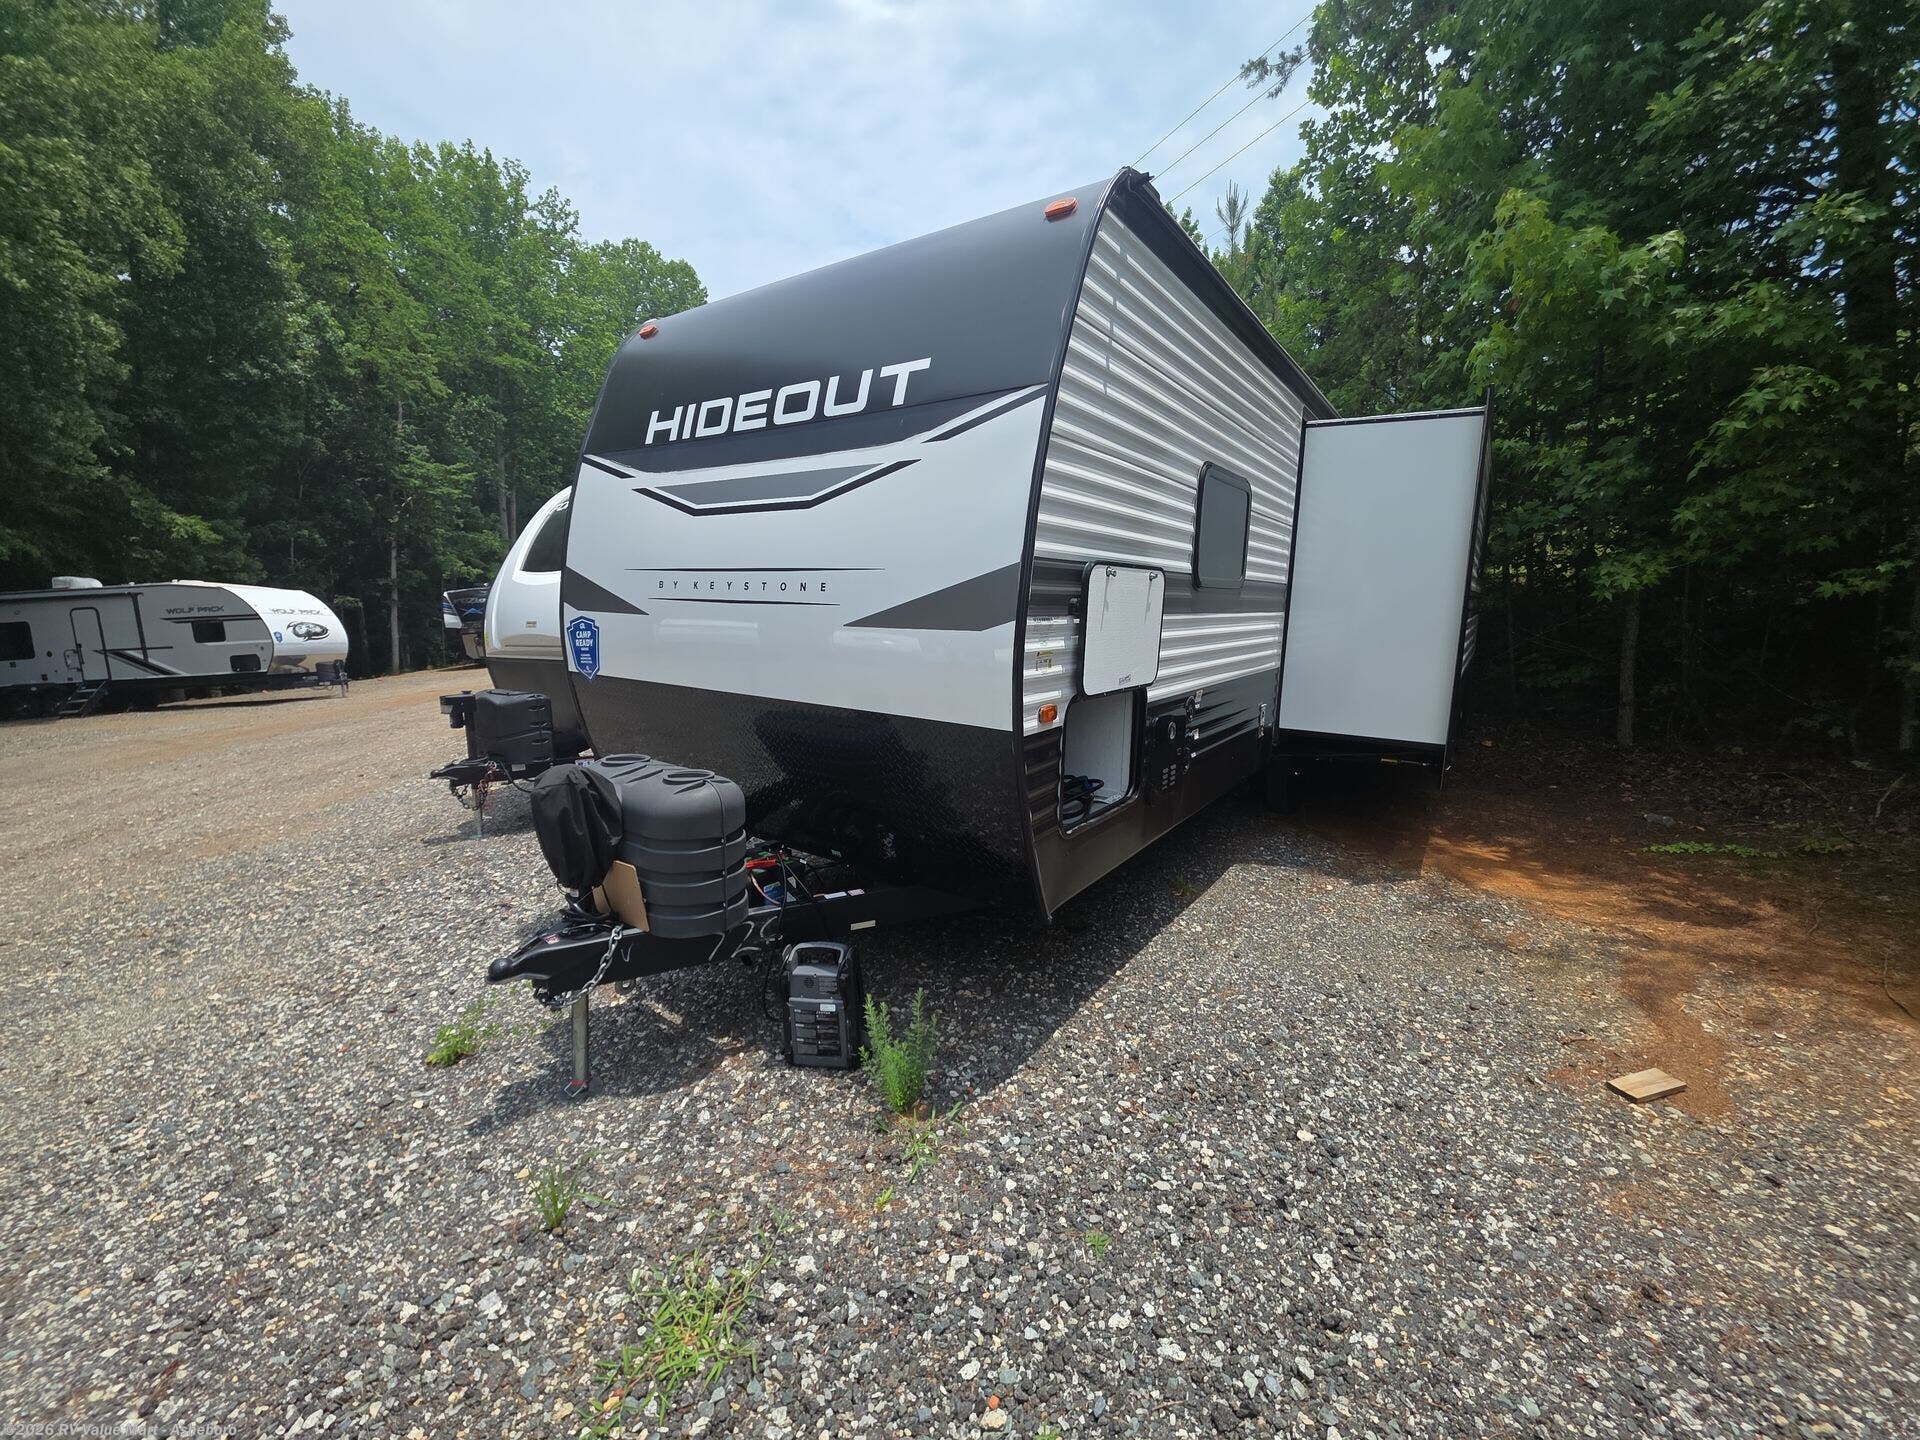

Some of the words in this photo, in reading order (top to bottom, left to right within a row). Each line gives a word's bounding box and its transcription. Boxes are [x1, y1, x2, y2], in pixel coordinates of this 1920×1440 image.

[644, 357, 932, 445] HIDEOUT
[658, 580, 679, 589] BY
[693, 581, 827, 592] KEYSTONE
[575, 630, 592, 639] CAMP
[575, 638, 594, 647] READY
